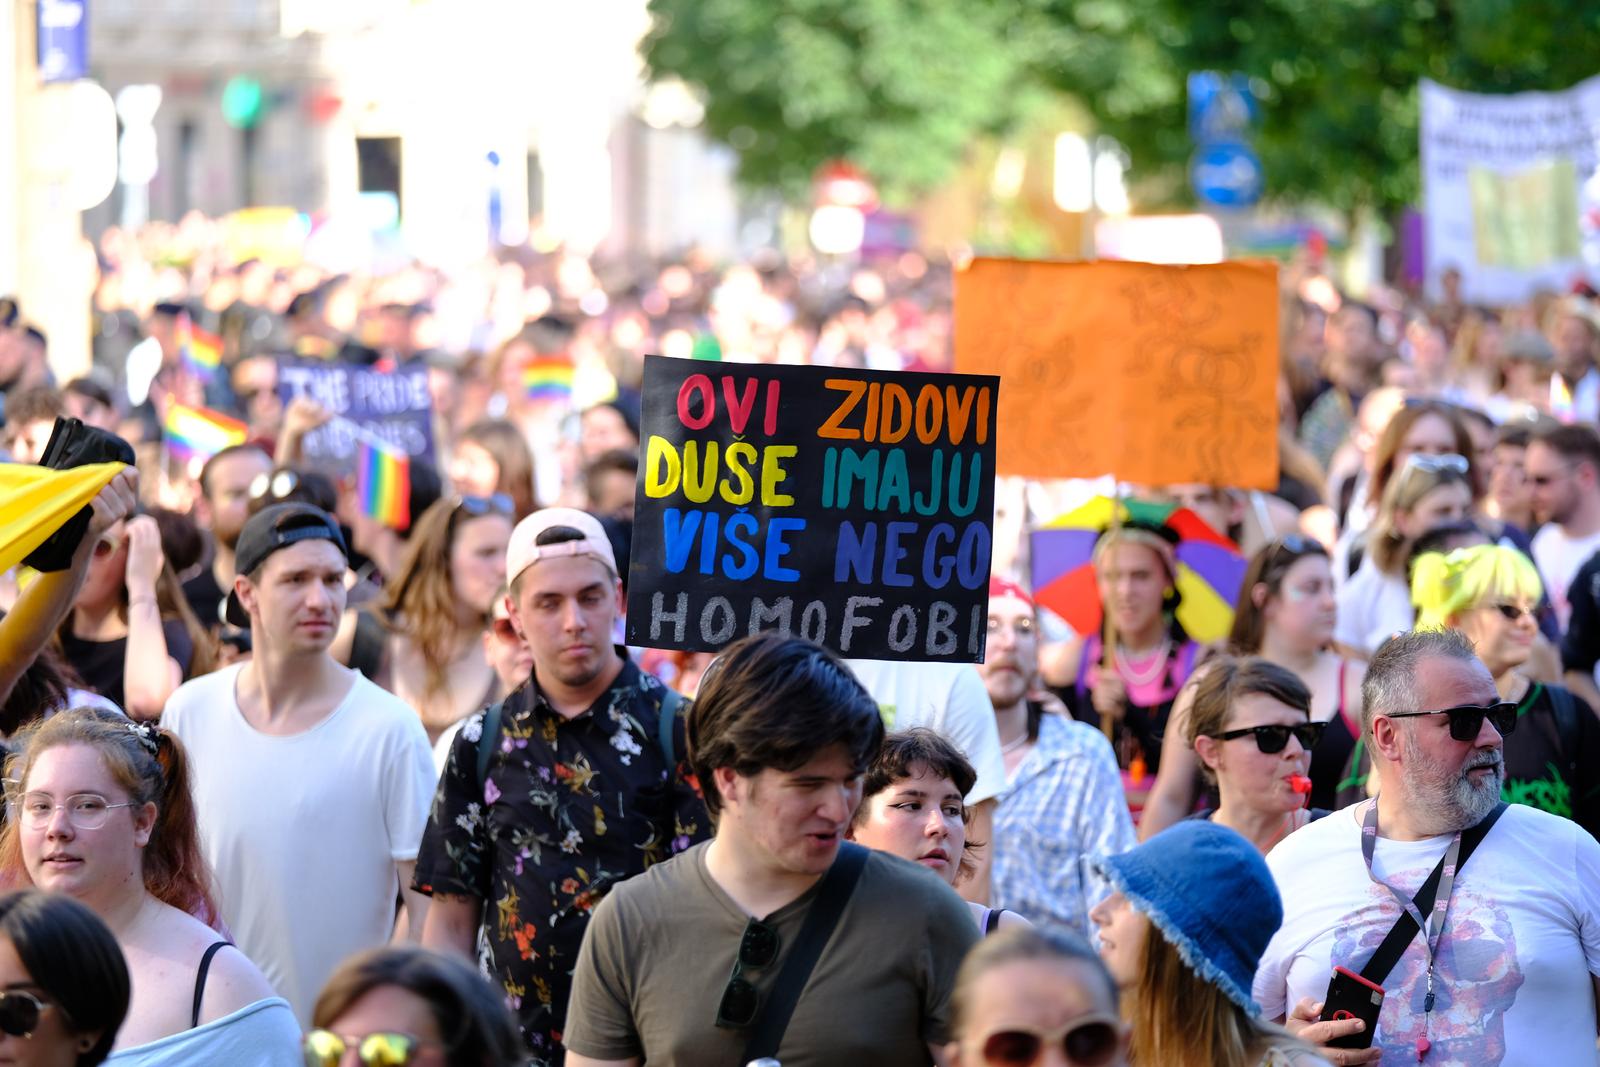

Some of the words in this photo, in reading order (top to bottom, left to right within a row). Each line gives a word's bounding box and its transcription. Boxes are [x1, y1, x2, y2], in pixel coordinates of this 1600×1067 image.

[677, 374, 780, 436] OVI
[817, 379, 990, 445] ZIDOVI
[645, 434, 798, 507] DUŠE
[822, 447, 982, 517] IMAJU
[664, 507, 806, 582] VIŠE
[834, 520, 991, 590] NEGO
[650, 591, 982, 656] HOMOFOBI
